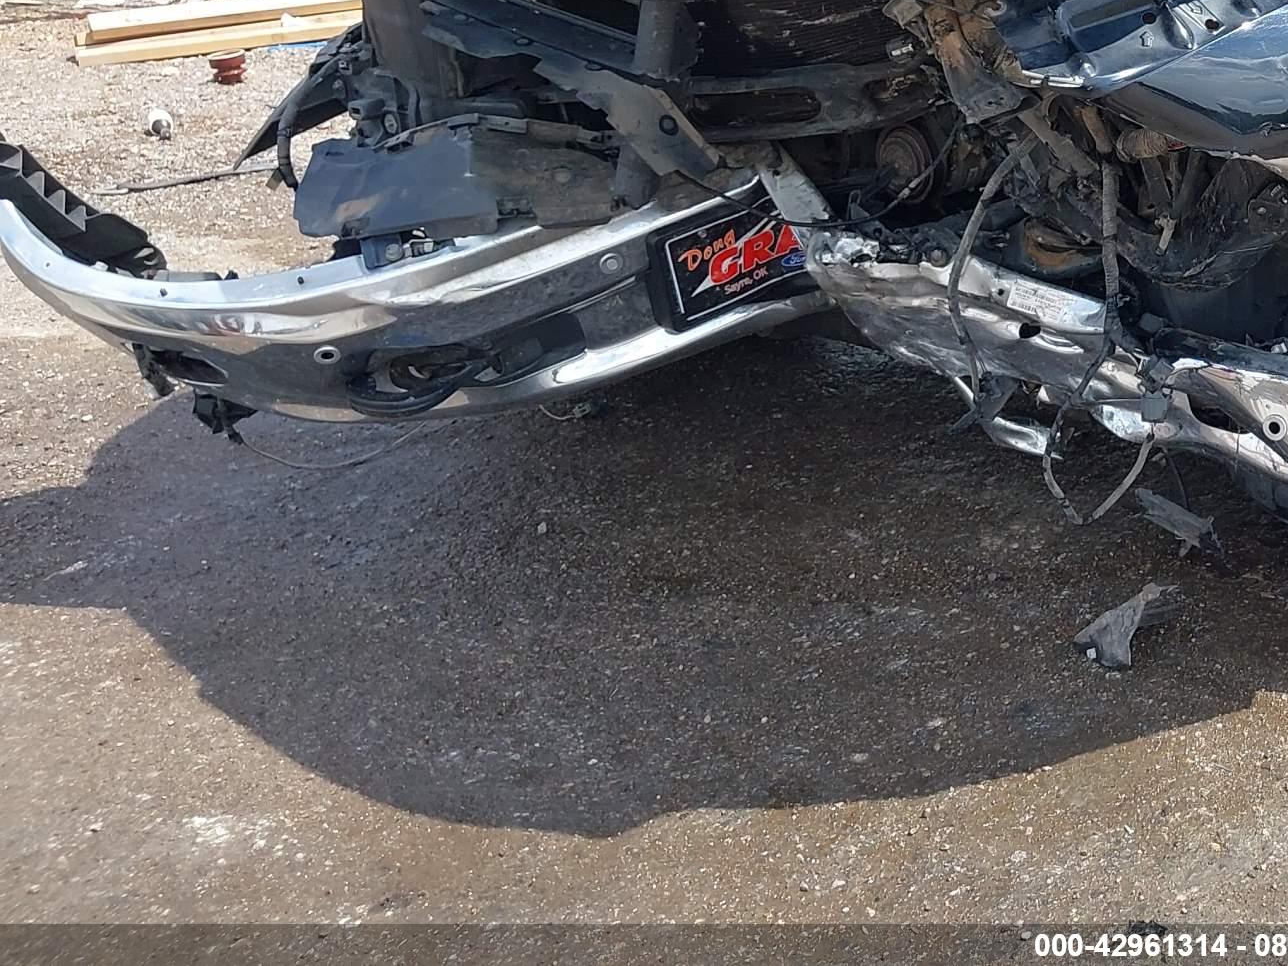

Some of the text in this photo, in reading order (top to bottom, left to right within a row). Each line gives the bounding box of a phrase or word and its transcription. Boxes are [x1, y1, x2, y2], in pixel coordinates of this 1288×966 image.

[677, 228, 736, 272] Doug
[708, 224, 804, 285] GRA
[753, 265, 769, 280] OK
